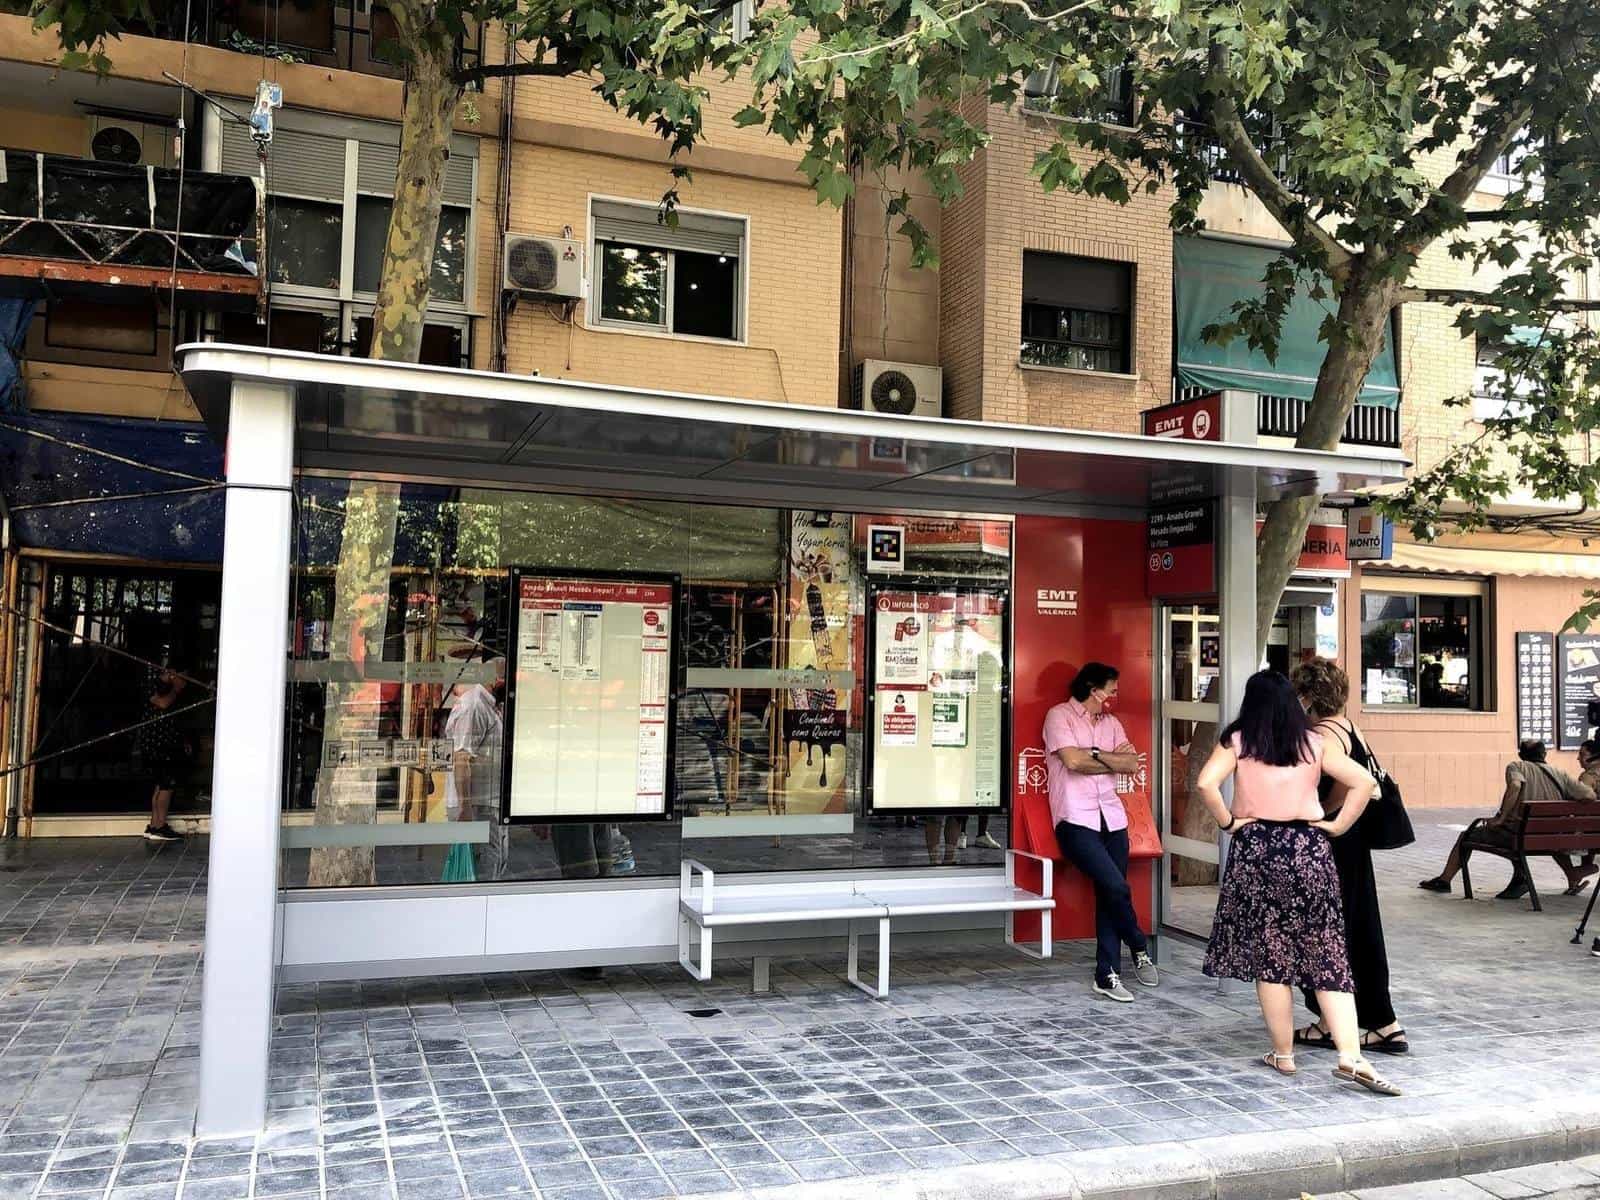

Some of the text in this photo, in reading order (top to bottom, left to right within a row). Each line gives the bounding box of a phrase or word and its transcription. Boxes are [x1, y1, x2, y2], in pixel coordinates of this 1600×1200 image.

[1155, 416, 1184, 432] EMT
[1349, 536, 1381, 548] MONTÓ
[1037, 589, 1078, 601] EMT
